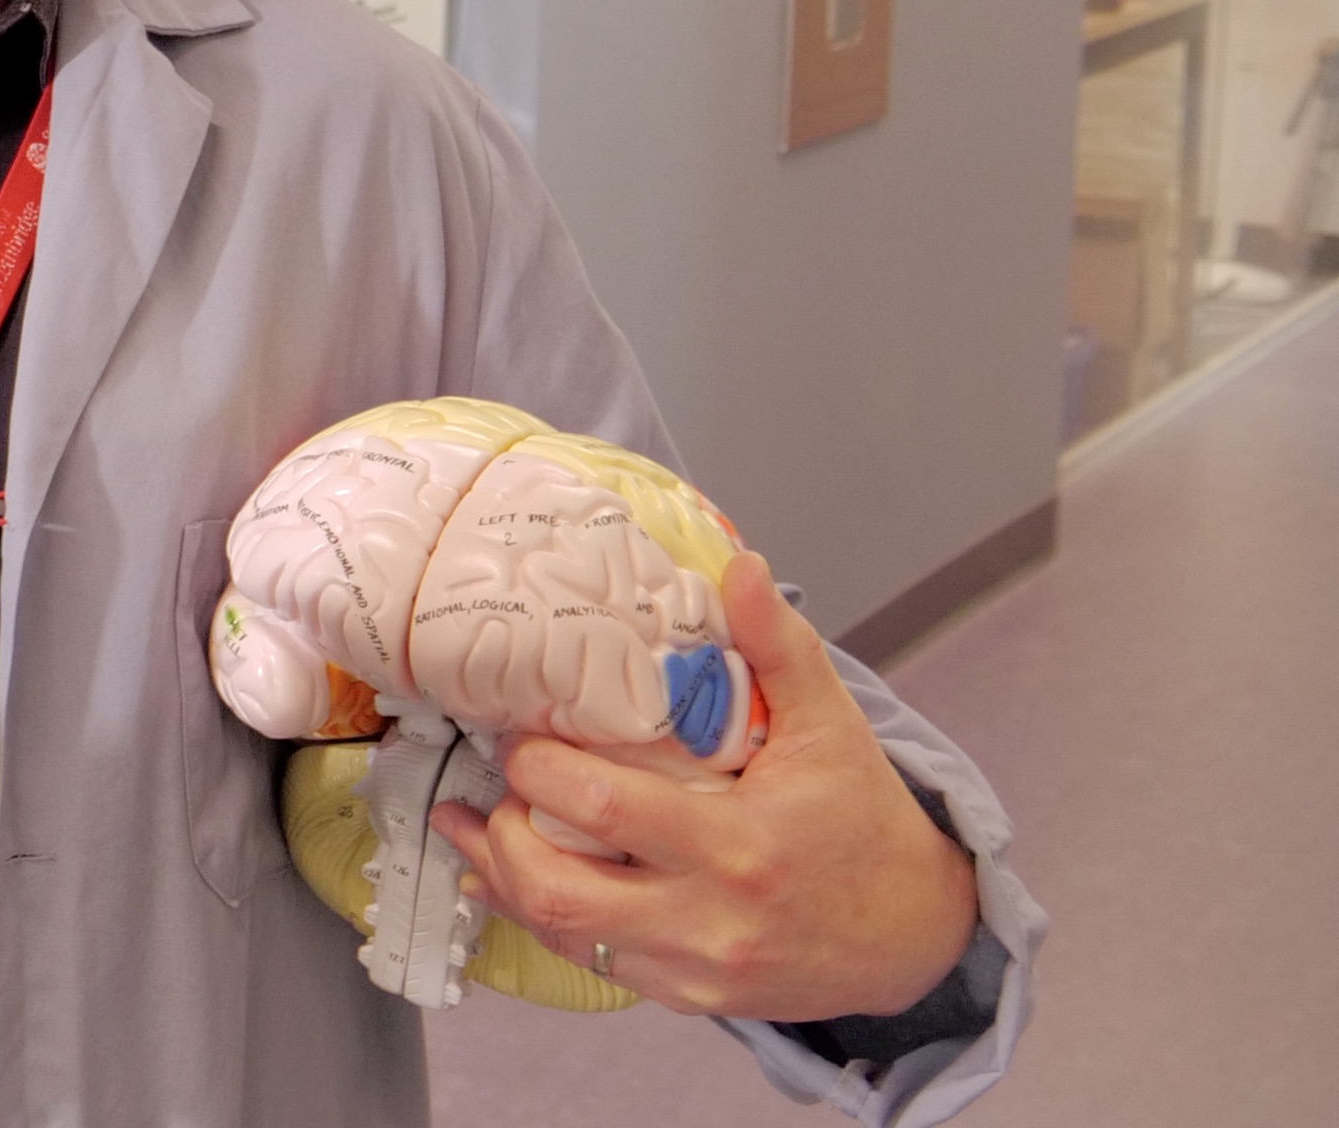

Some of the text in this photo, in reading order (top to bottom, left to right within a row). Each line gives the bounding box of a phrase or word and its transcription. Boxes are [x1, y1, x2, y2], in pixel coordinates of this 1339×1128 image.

[478, 512, 519, 527] LEFT
[504, 532, 517, 547] 2
[351, 583, 369, 610] AND
[361, 615, 392, 665] SPATIAL
